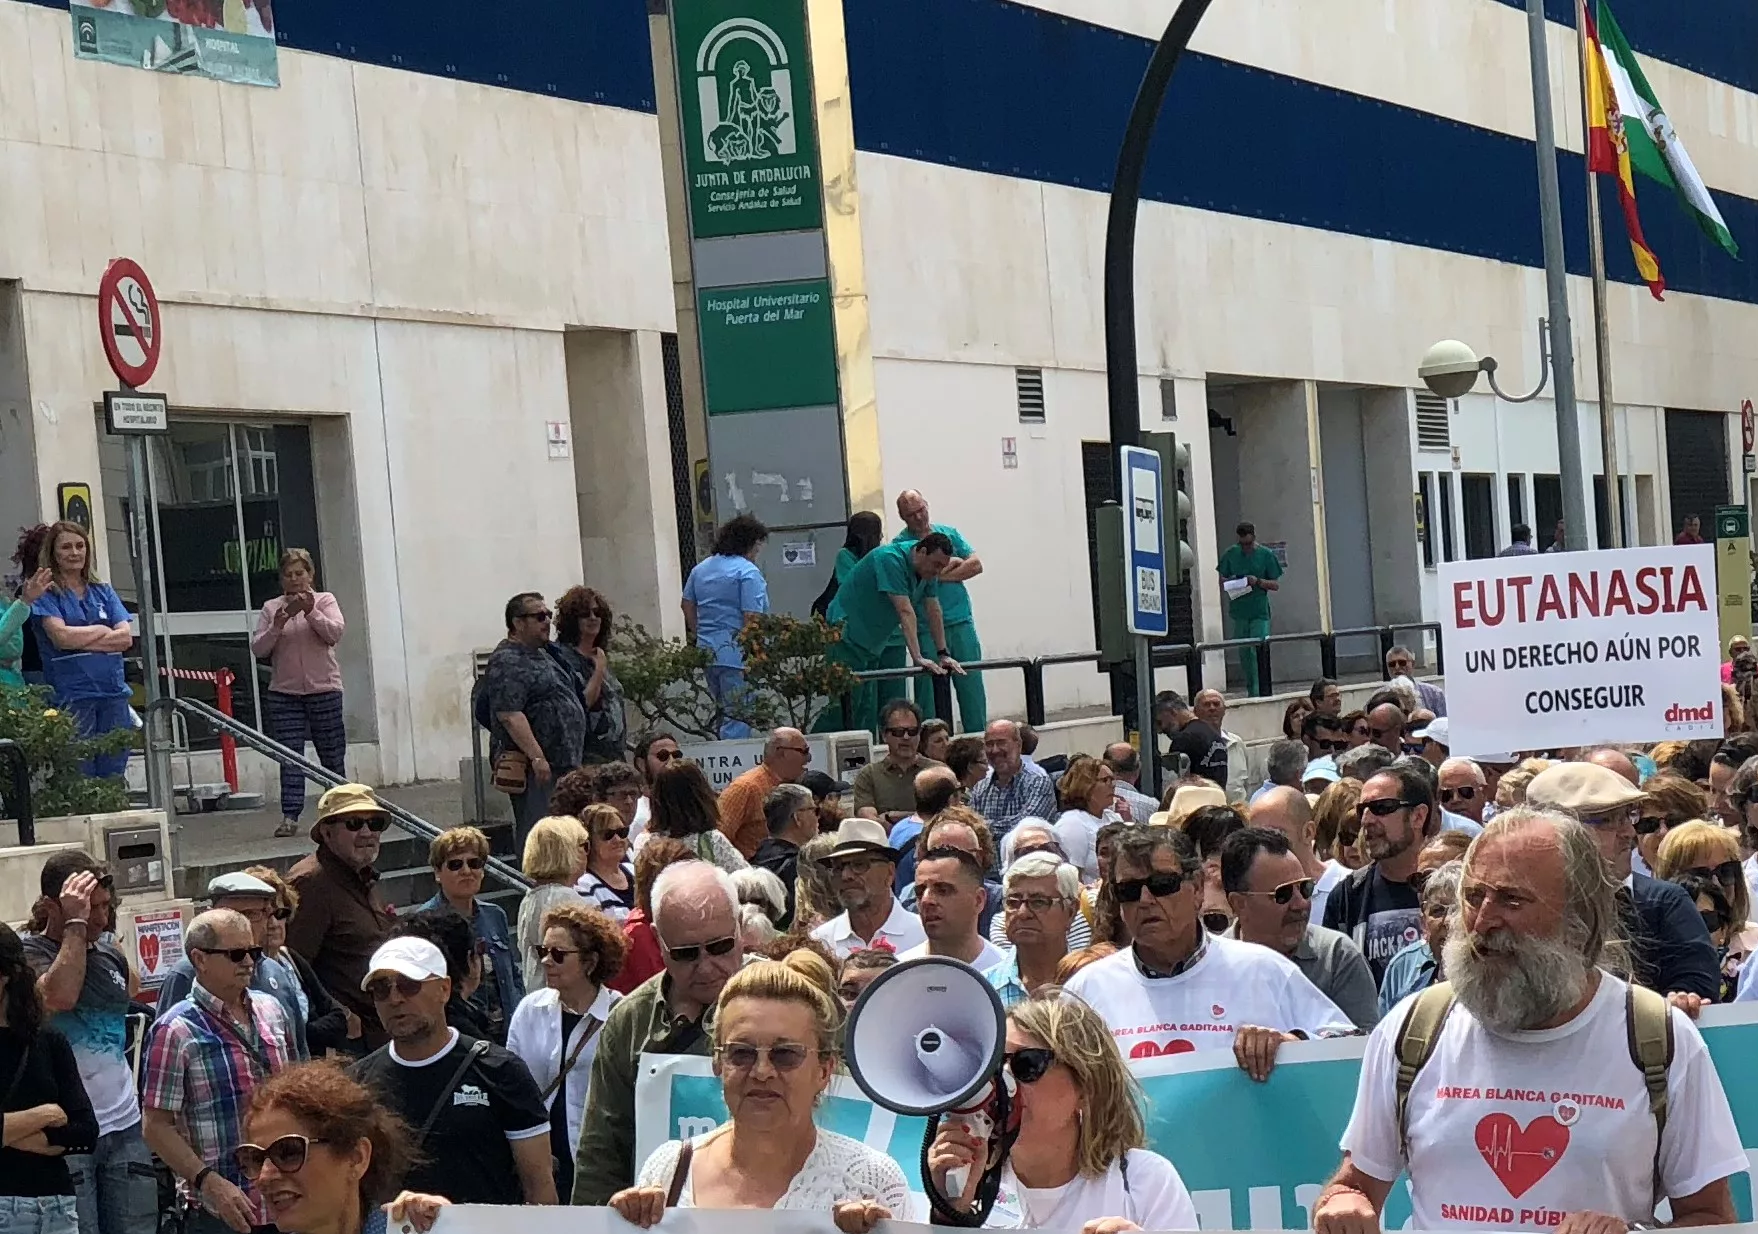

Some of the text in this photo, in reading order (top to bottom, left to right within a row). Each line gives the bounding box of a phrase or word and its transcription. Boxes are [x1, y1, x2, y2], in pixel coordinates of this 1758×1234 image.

[695, 172, 729, 187] JUNTA
[733, 170, 747, 184] DE
[757, 187, 770, 198] de
[772, 184, 797, 197] Salud
[707, 196, 802, 213] Servicio Andaluz de Salud
[706, 292, 820, 313] Hospital Universitario
[725, 308, 806, 326] Puerta del Mar
[1141, 569, 1156, 592] BUS
[1453, 565, 1709, 629] EUTANASIA
[1465, 632, 1701, 673] UN DERECHO AÚN POR
[1525, 684, 1645, 714] CONSEGUIR
[1664, 701, 1714, 722] dmd
[696, 755, 743, 770] NTRA
[713, 772, 733, 784] UN
[1137, 1023, 1178, 1034] BLANCA
[1180, 1023, 1234, 1033] GADITANA
[1436, 1086, 1481, 1100] MAREA
[1485, 1088, 1546, 1103] BLANCA
[1441, 1203, 1515, 1224] SANIDAD
